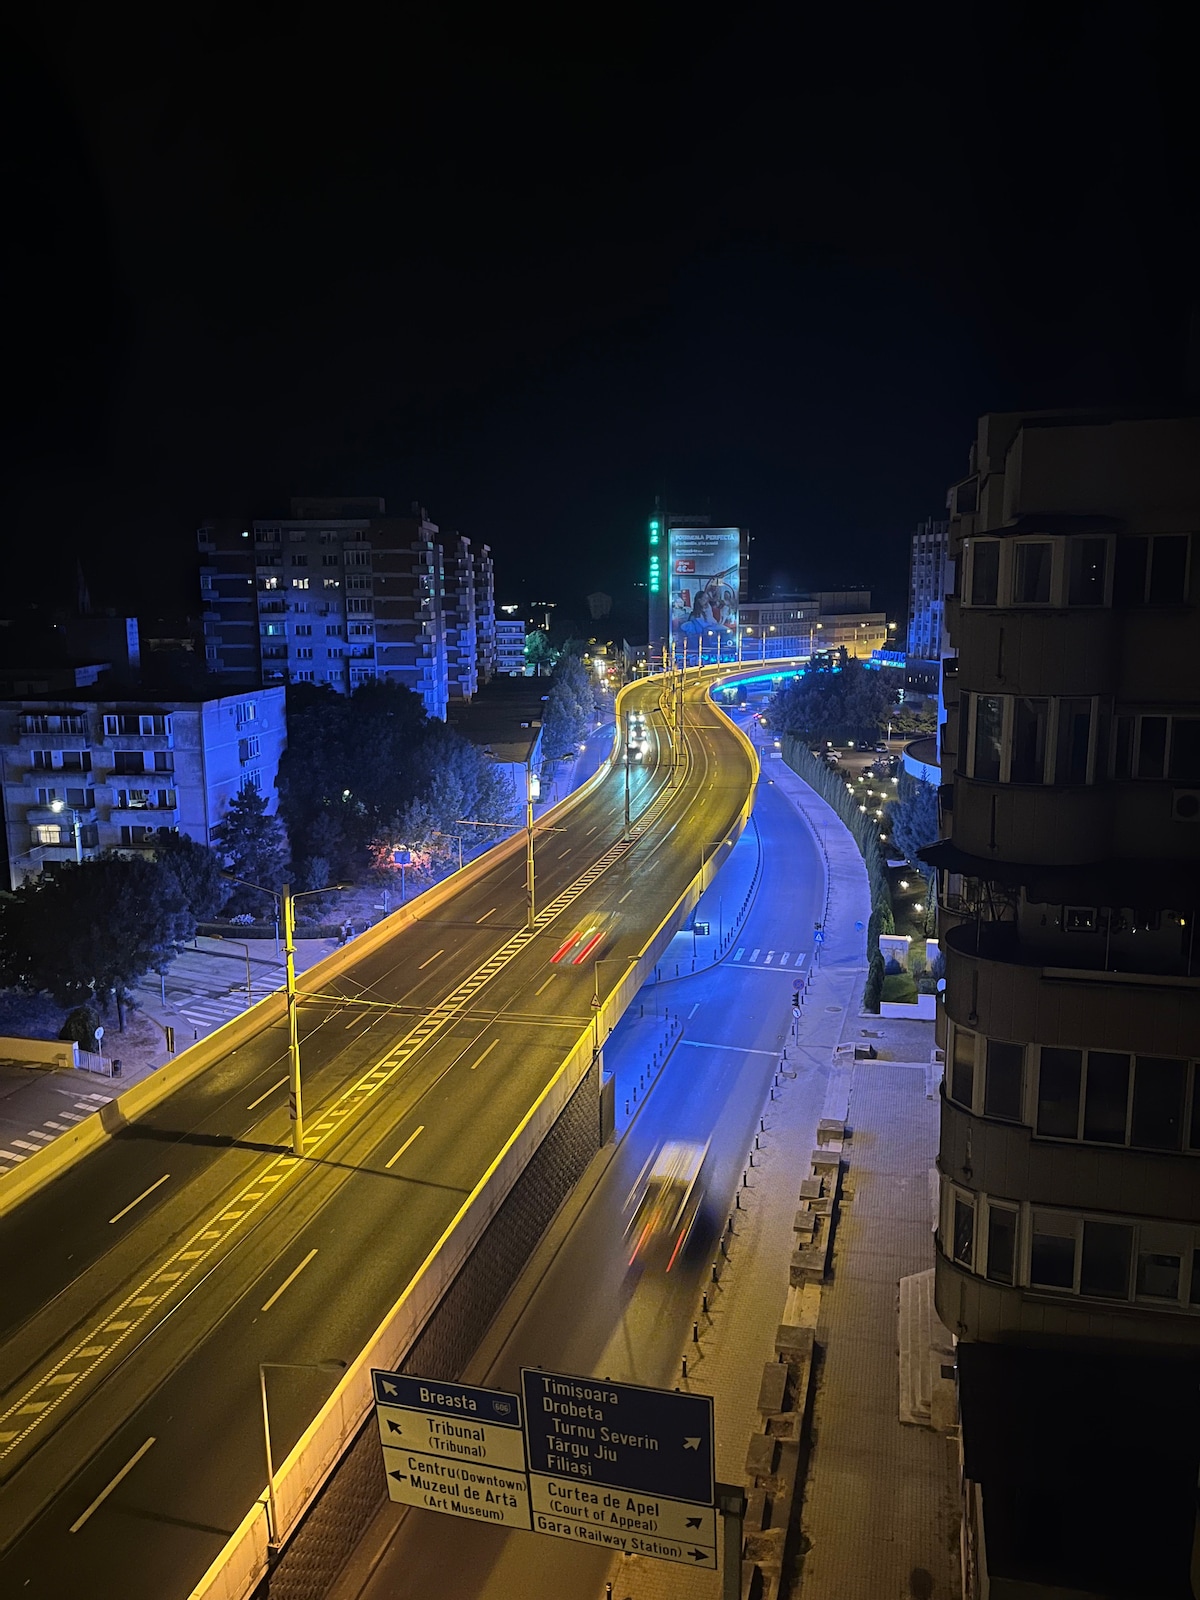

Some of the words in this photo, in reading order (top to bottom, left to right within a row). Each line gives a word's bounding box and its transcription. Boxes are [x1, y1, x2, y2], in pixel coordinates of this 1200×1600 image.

[419, 1387, 477, 1411] Breasta
[542, 1377, 618, 1404] Timișoara
[543, 1396, 603, 1421] Drobeta
[426, 1418, 485, 1441] Tribunal
[552, 1418, 595, 1439] Turnu
[600, 1426, 659, 1451] Severin
[429, 1436, 486, 1458] (Tribunal)
[594, 1445, 617, 1462] Jiu
[547, 1454, 592, 1476] Filiași
[410, 1474, 460, 1497] Muzeul
[464, 1486, 480, 1500] de
[548, 1482, 599, 1504] Curtea
[603, 1494, 620, 1508] de
[626, 1498, 659, 1517] Apel
[424, 1494, 448, 1510] (Art
[451, 1501, 504, 1521] Museum)
[550, 1499, 589, 1519] (Court
[593, 1510, 605, 1521] of
[610, 1512, 658, 1532] Appeal)
[538, 1516, 571, 1535] Gara
[574, 1525, 627, 1549] (Railway
[631, 1538, 682, 1558] Station)
